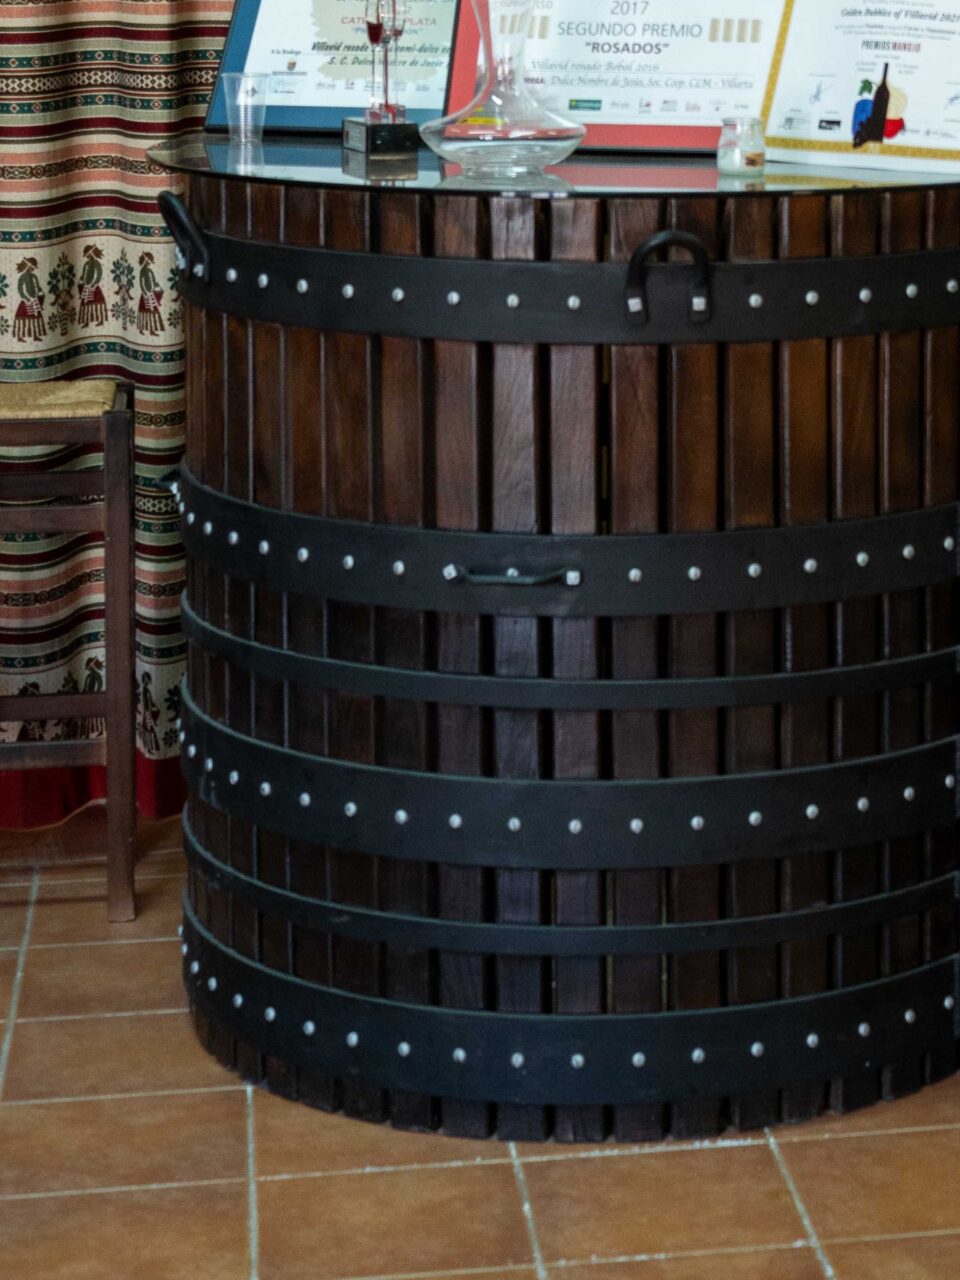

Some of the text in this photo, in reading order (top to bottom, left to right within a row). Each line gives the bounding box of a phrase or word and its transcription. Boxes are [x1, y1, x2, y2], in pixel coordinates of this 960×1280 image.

[610, 0, 649, 16] 2017
[557, 21, 703, 38] SEGUNDO PREMIO
[585, 41, 670, 55] "ROSADOS"
